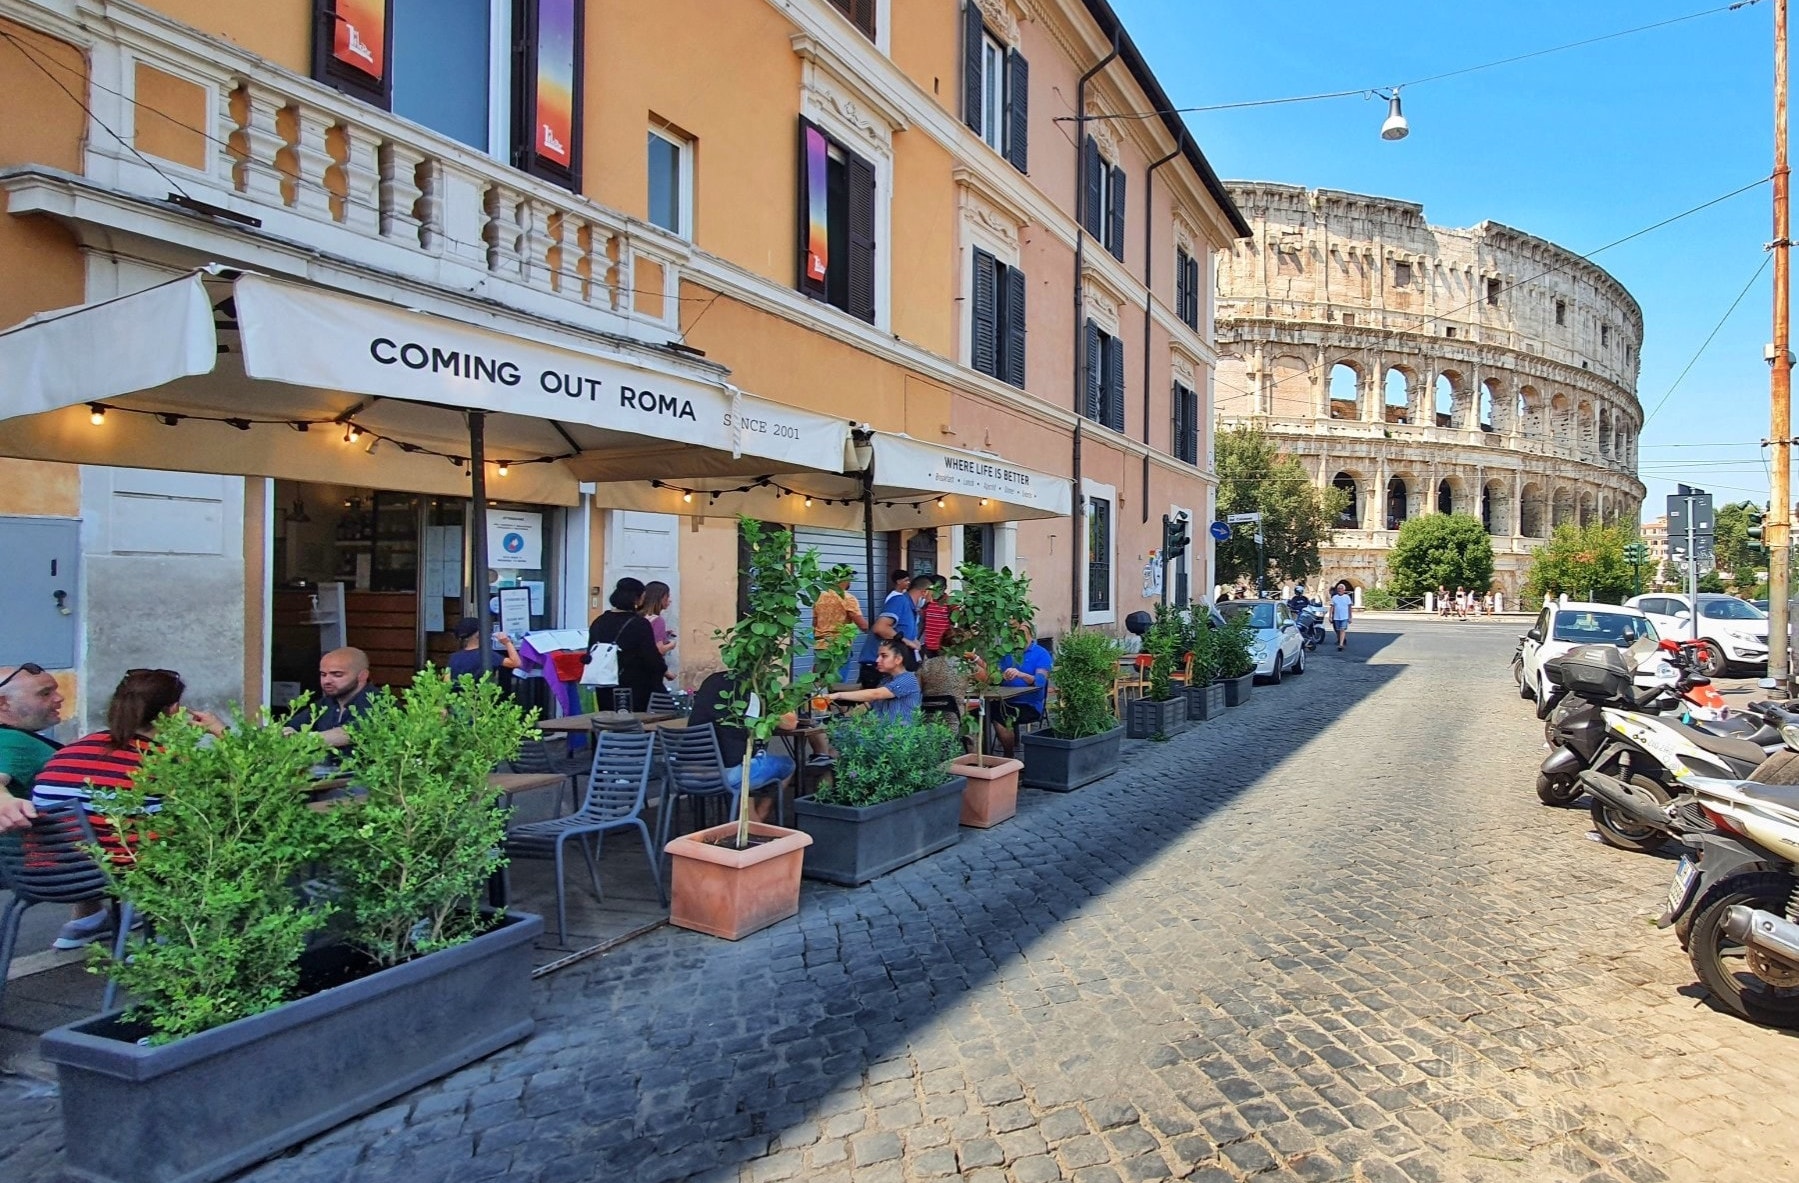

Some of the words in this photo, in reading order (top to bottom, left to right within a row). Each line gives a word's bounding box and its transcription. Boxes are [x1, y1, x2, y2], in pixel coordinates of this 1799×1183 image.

[370, 337, 521, 387] COMING
[540, 370, 602, 402] OUT
[620, 385, 697, 422] ROMA
[723, 413, 768, 433] SNCE
[773, 423, 800, 440] 2001
[944, 456, 974, 474] WHERE
[976, 463, 993, 478] LIFE
[994, 467, 1002, 479] IS
[1003, 469, 1030, 486] BETTER
